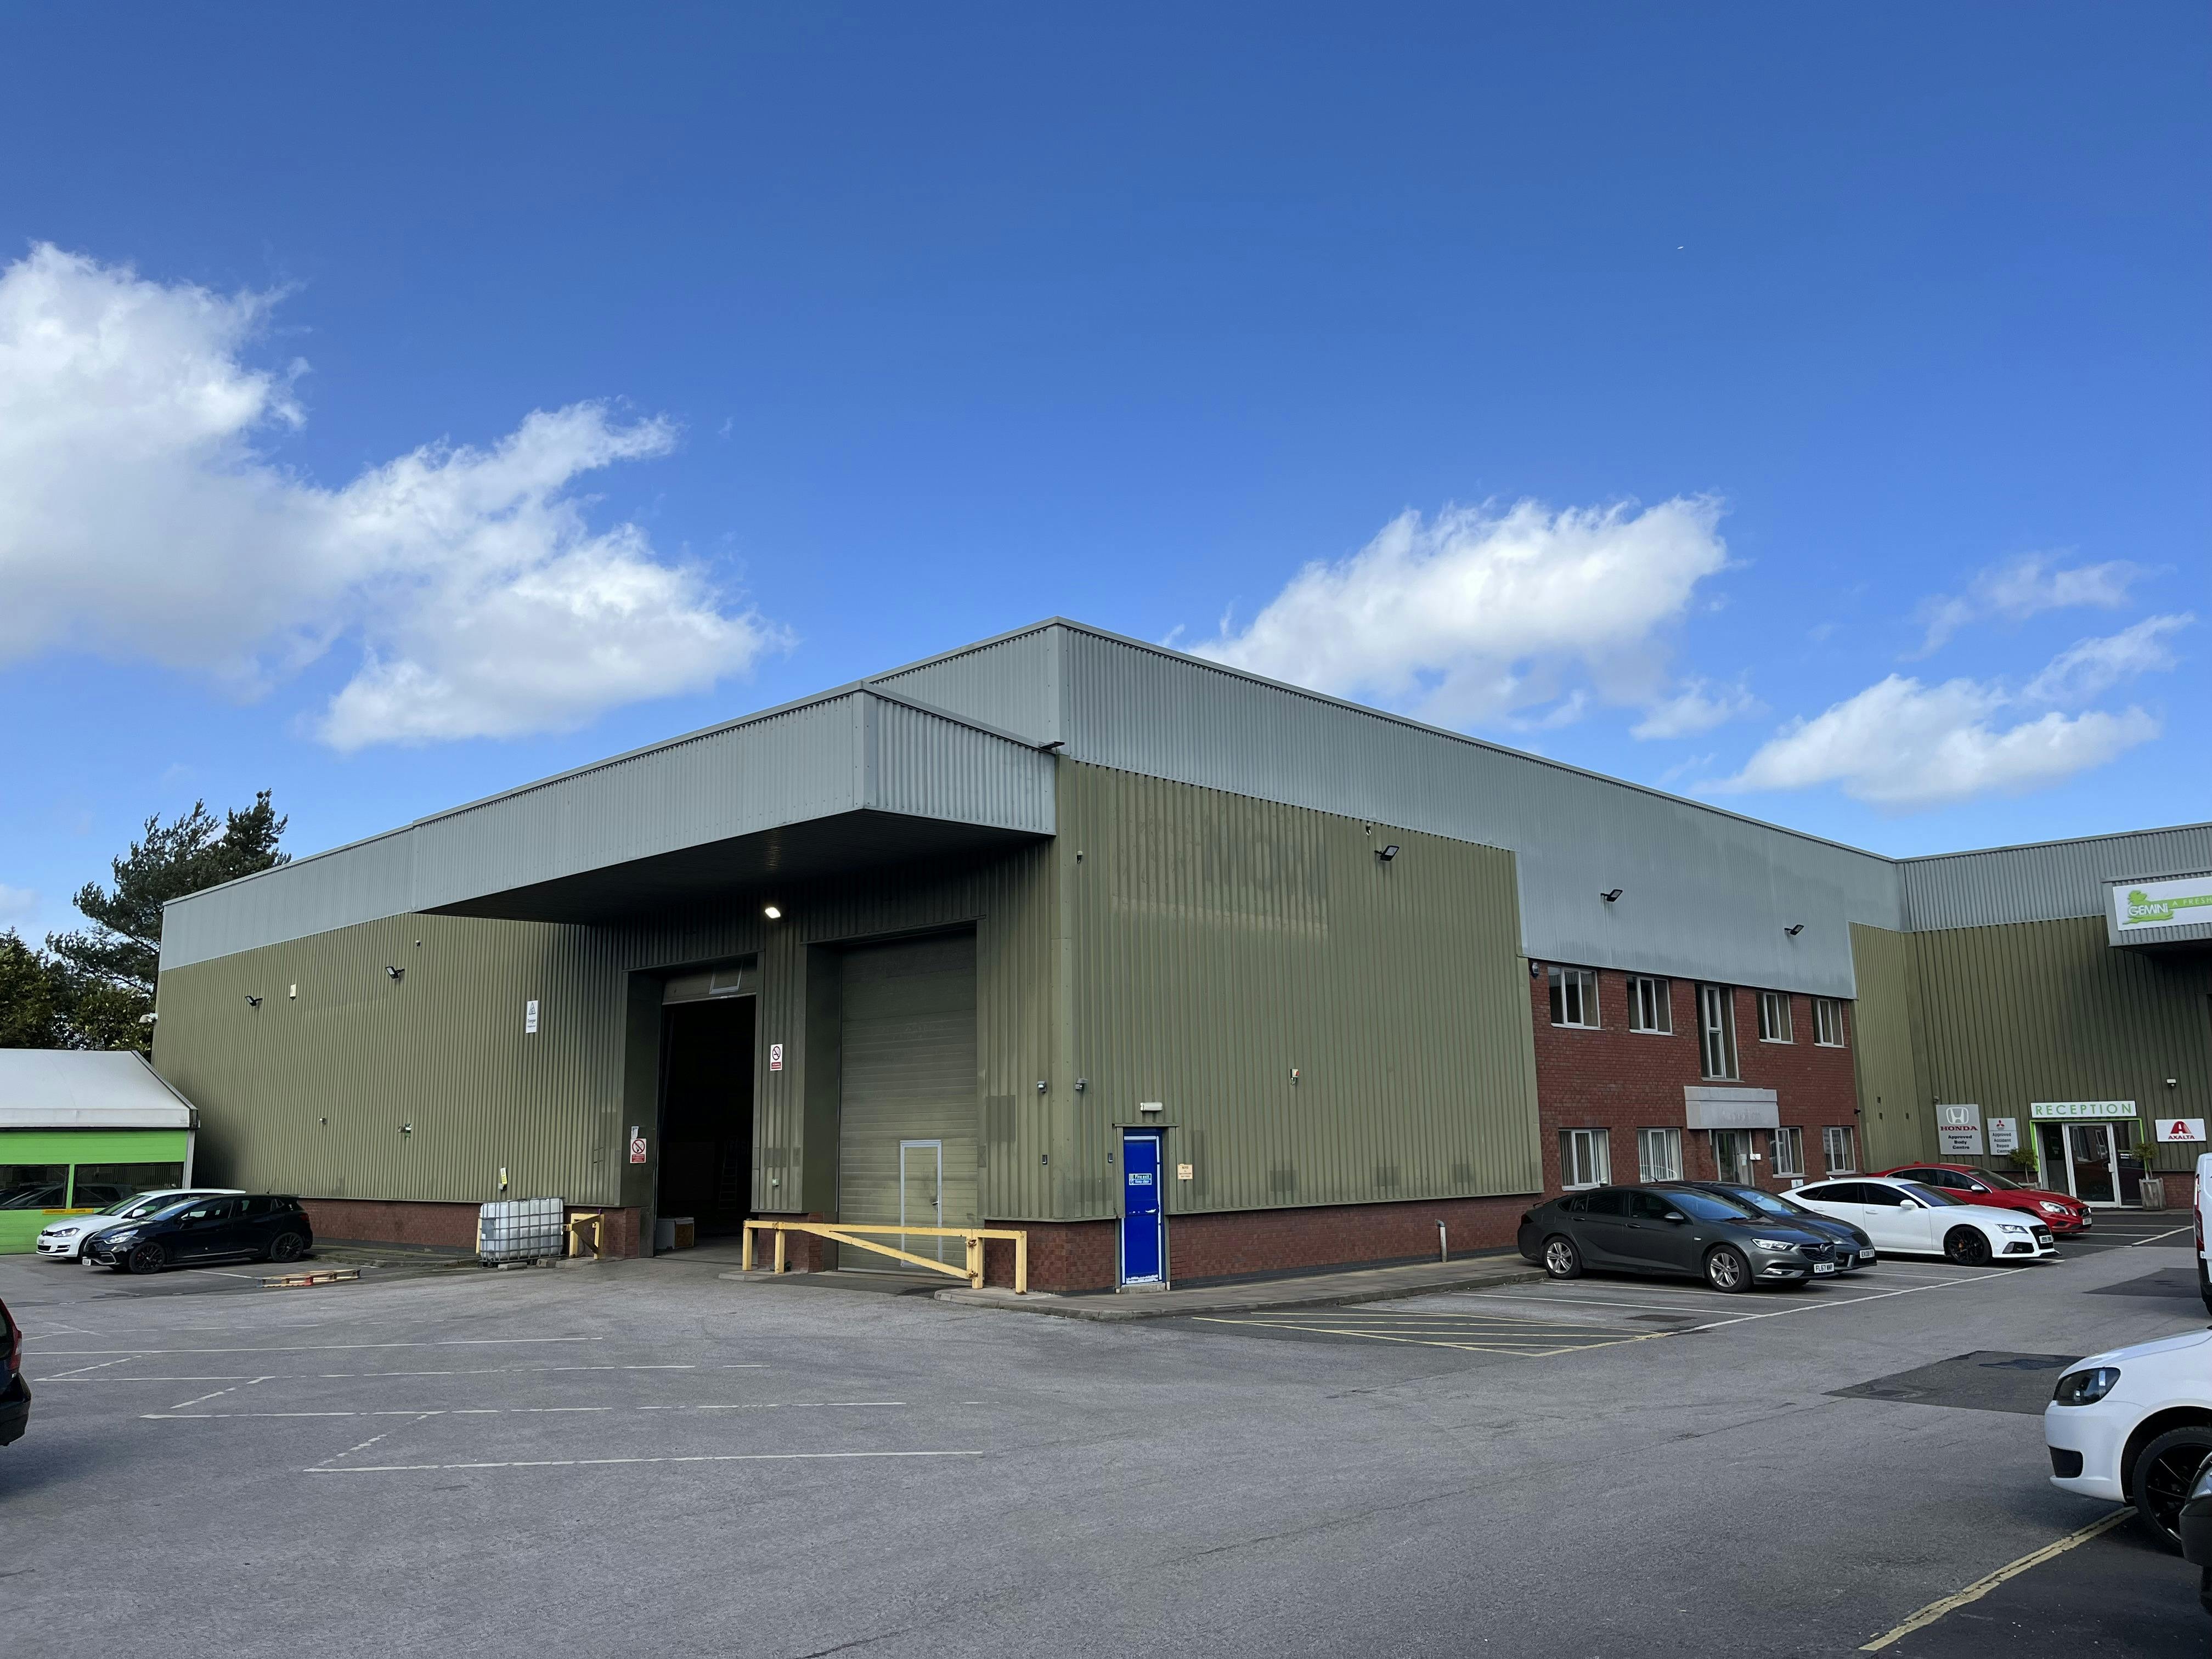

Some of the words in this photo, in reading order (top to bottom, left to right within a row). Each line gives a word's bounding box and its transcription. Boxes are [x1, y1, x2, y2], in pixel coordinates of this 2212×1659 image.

[2183, 897, 2212, 905] FRESH
[2128, 903, 2169, 916] GEMINI
[2035, 1104, 2132, 1115] RECEPTION
